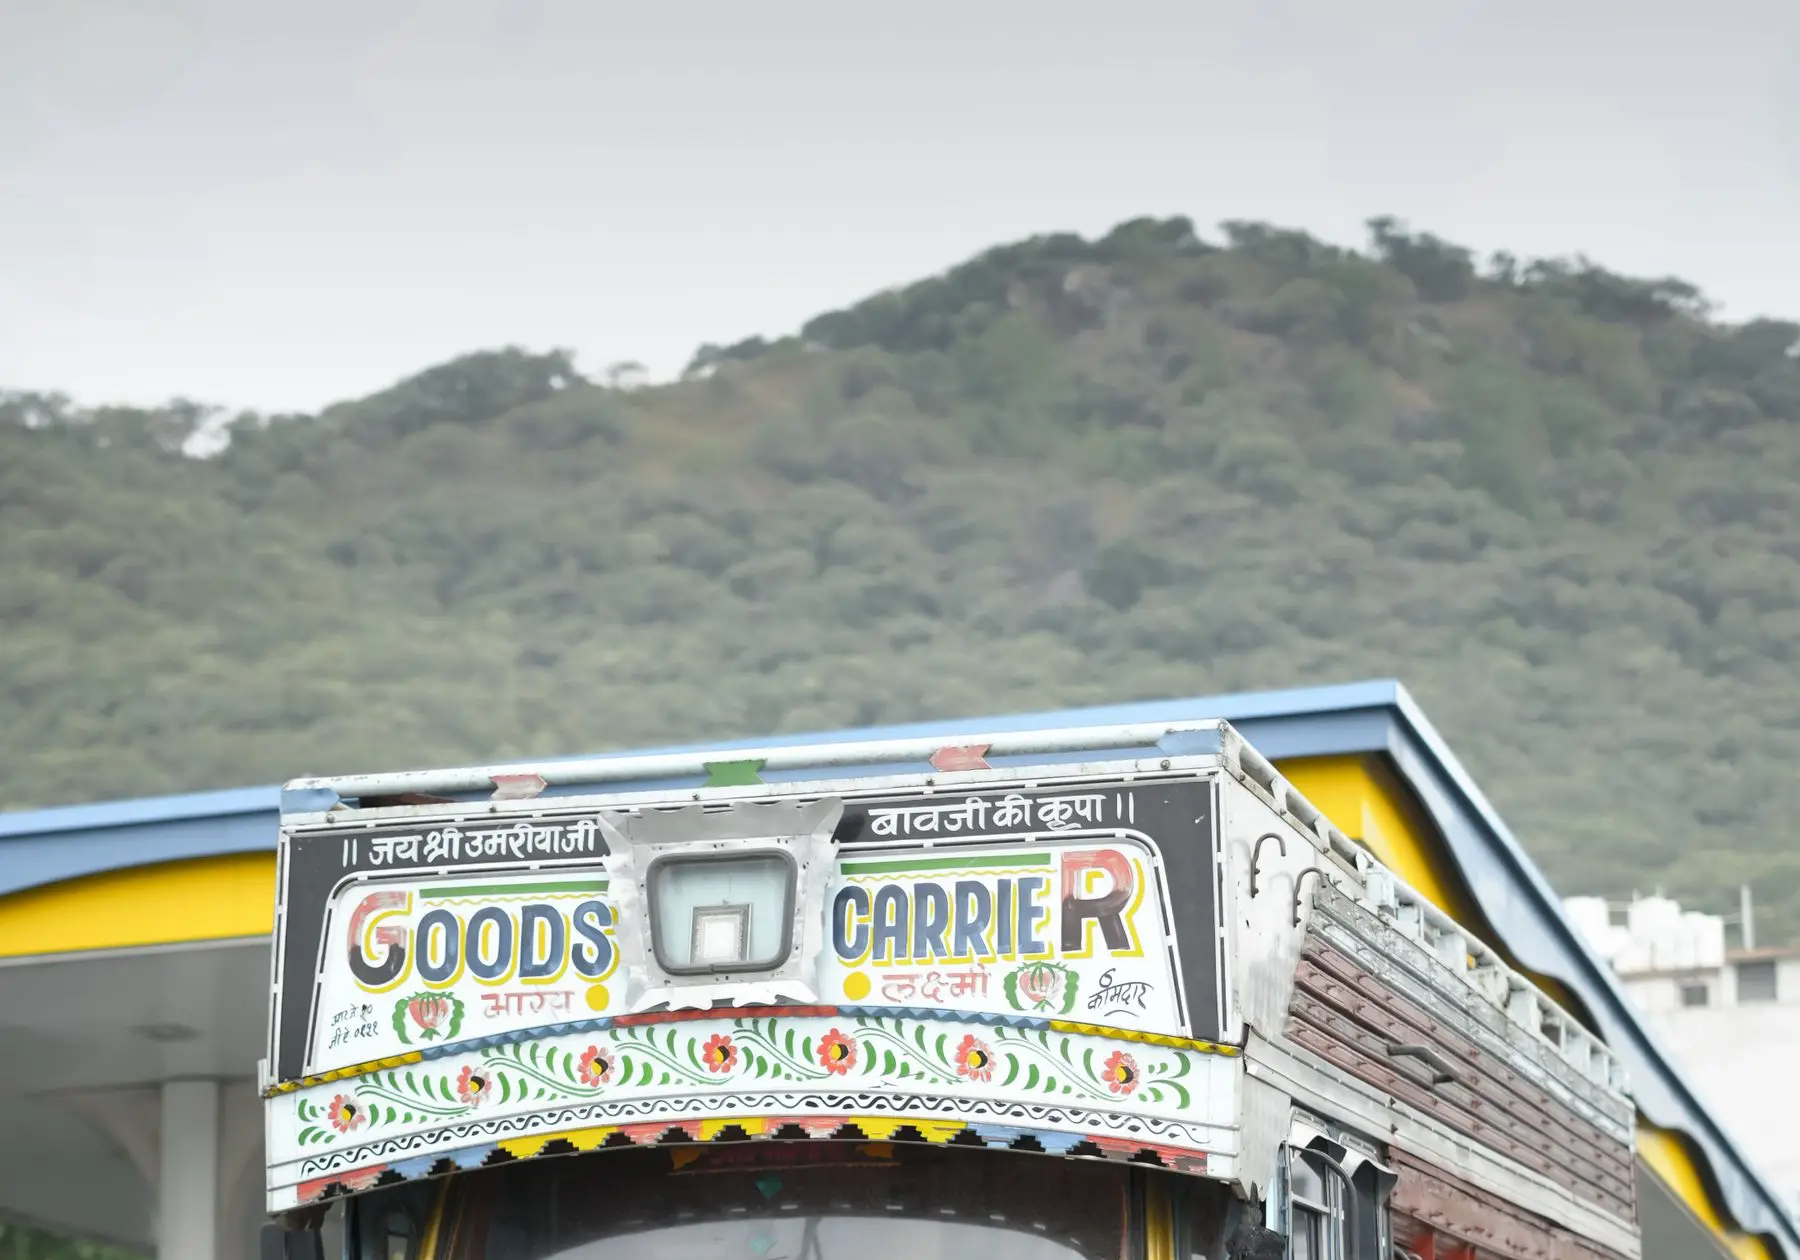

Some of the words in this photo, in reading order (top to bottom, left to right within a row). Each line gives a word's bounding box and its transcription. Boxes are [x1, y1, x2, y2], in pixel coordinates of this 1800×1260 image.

[369, 834, 422, 866] जय
[423, 827, 463, 864] श्री
[868, 796, 992, 836] बावजी
[992, 794, 1033, 828] की
[348, 890, 620, 994] GOODS
[832, 849, 1145, 968] CARRIER
